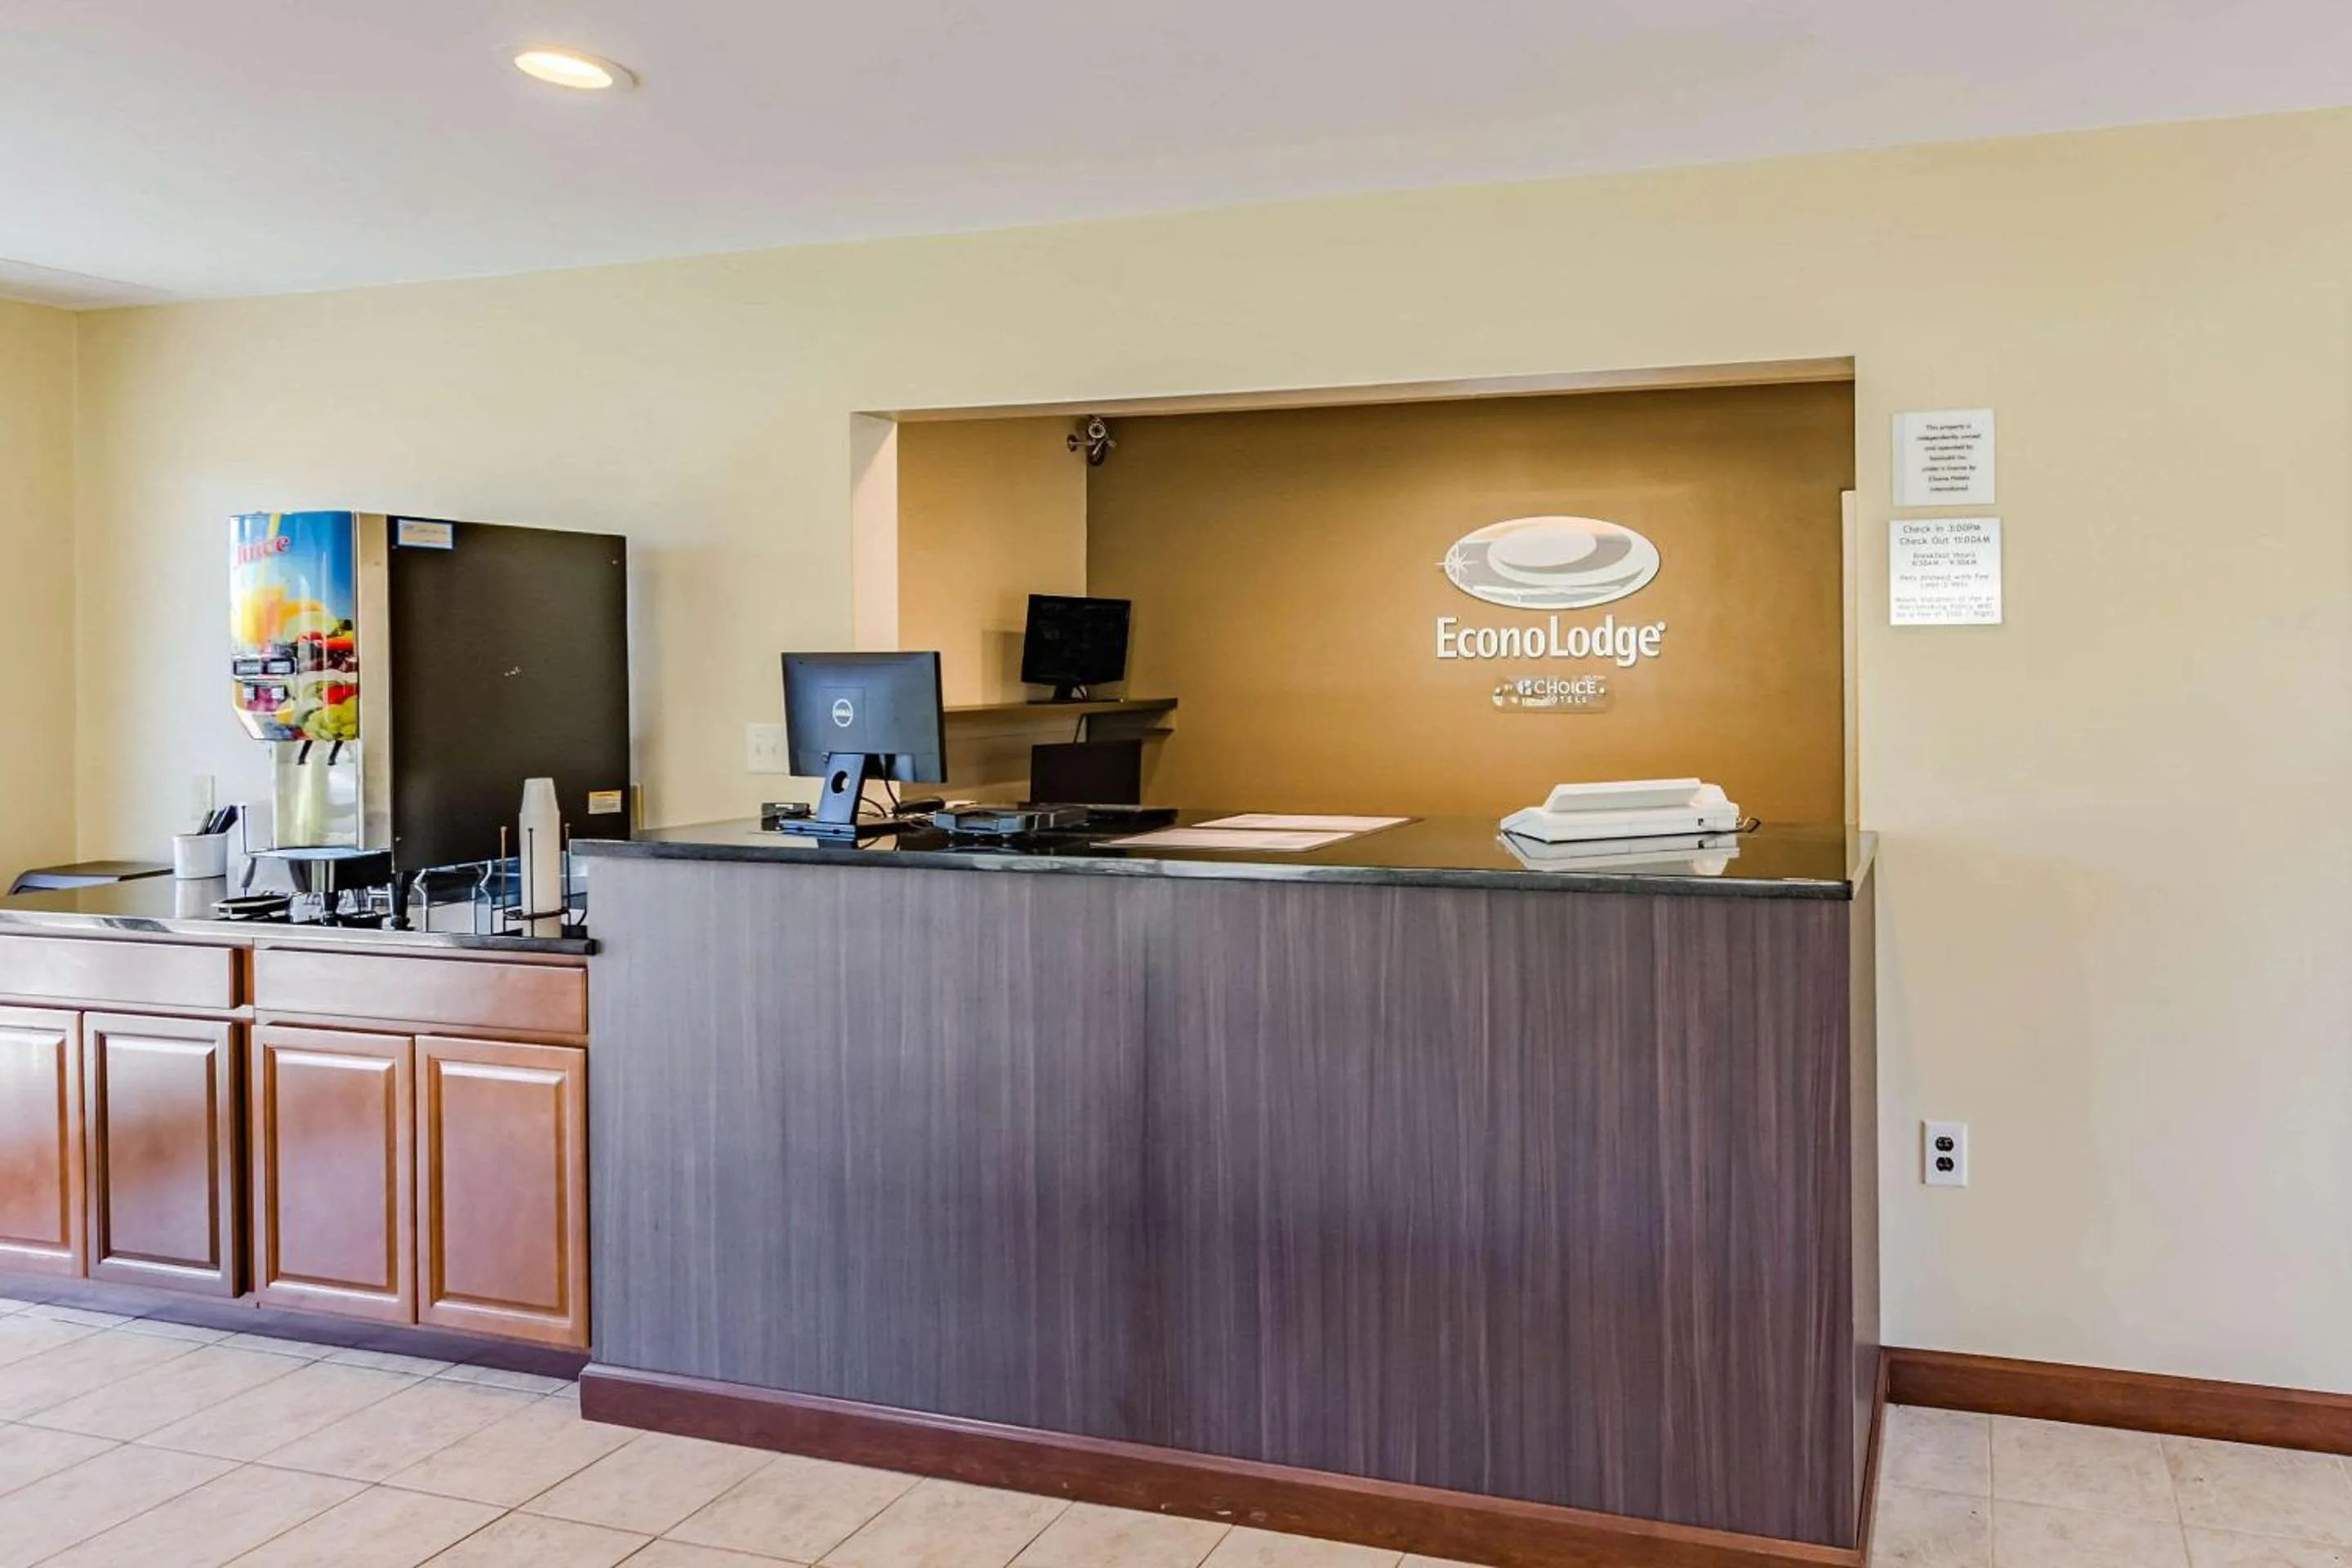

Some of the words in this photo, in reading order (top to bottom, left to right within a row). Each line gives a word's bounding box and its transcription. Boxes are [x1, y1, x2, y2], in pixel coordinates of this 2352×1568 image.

[1903, 524, 1931, 533] Check
[1899, 537, 1927, 546] Check
[1931, 536, 1949, 545] Out
[1534, 679, 1597, 695] CHOICE
